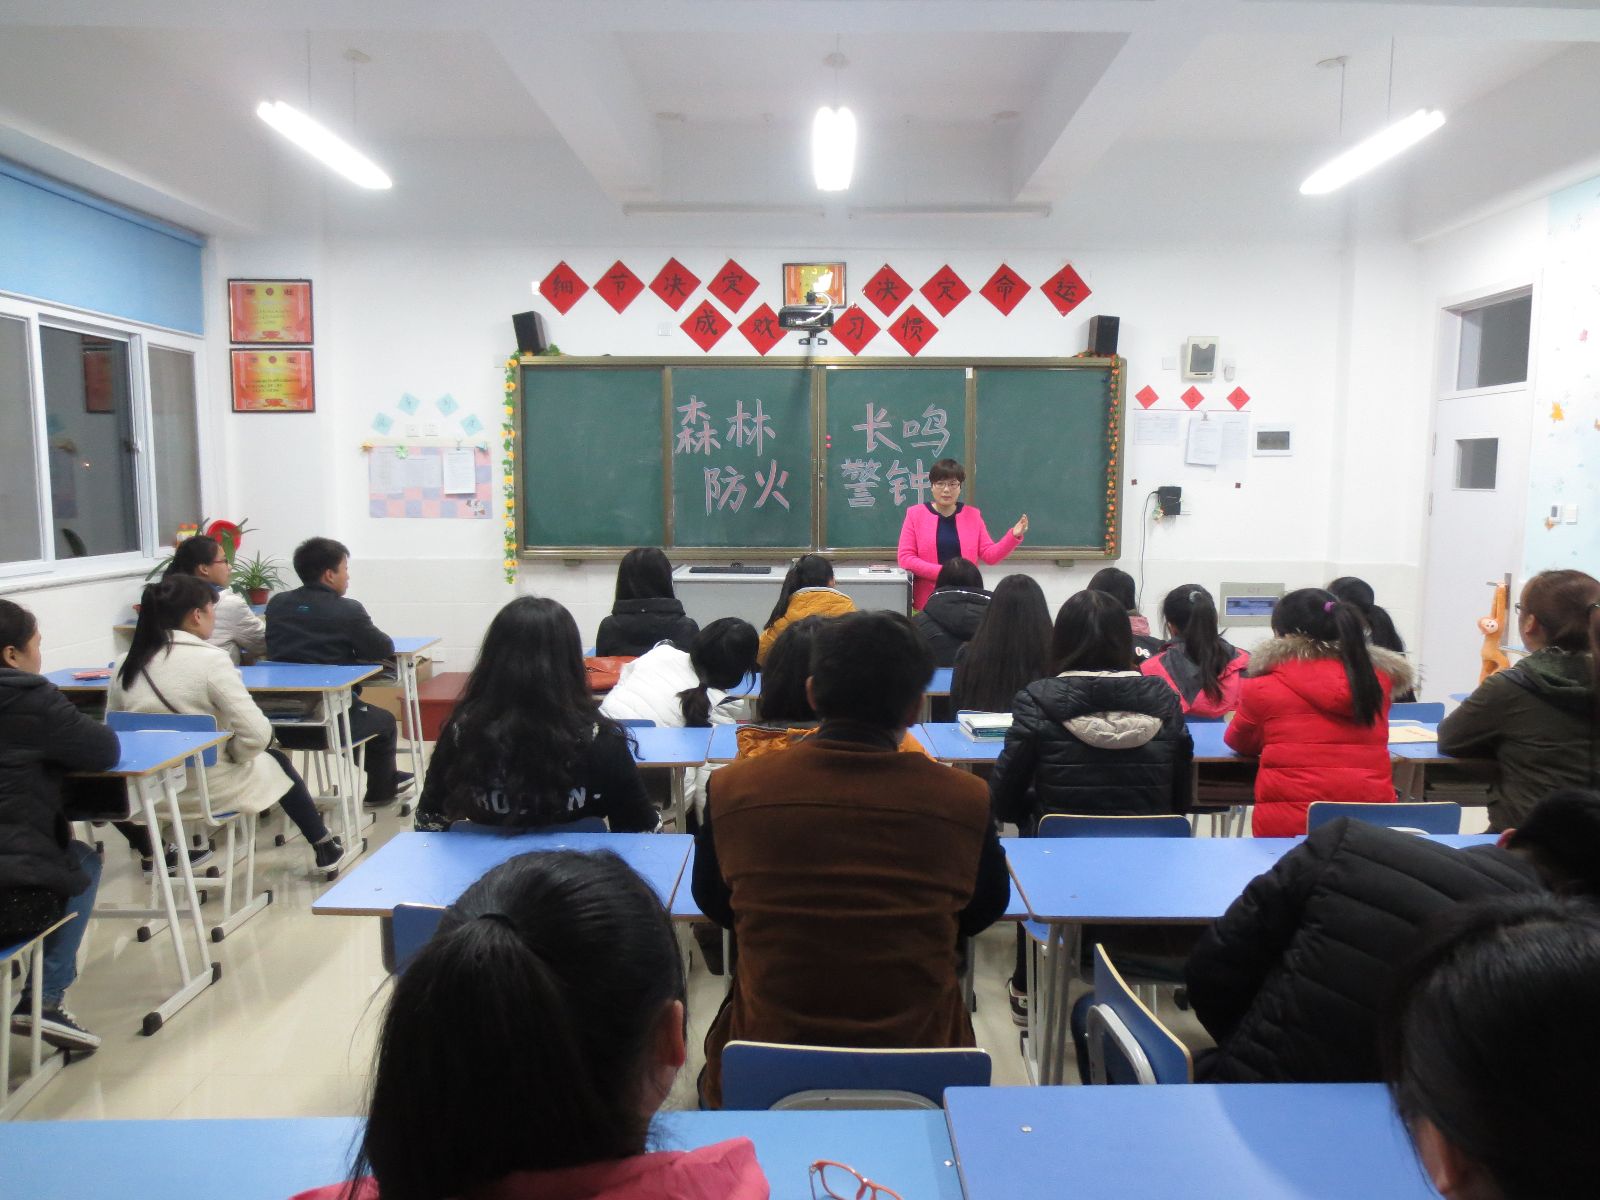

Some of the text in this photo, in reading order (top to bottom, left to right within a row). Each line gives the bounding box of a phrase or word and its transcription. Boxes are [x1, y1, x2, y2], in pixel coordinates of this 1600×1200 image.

[552, 272, 744, 298] 细节决定
[875, 274, 1078, 304] 决定命运
[846, 315, 924, 343] 习惯
[675, 394, 777, 456] 森林
[852, 401, 951, 458] 长鸣
[704, 458, 791, 517] 防火
[841, 458, 932, 508] 警钟
